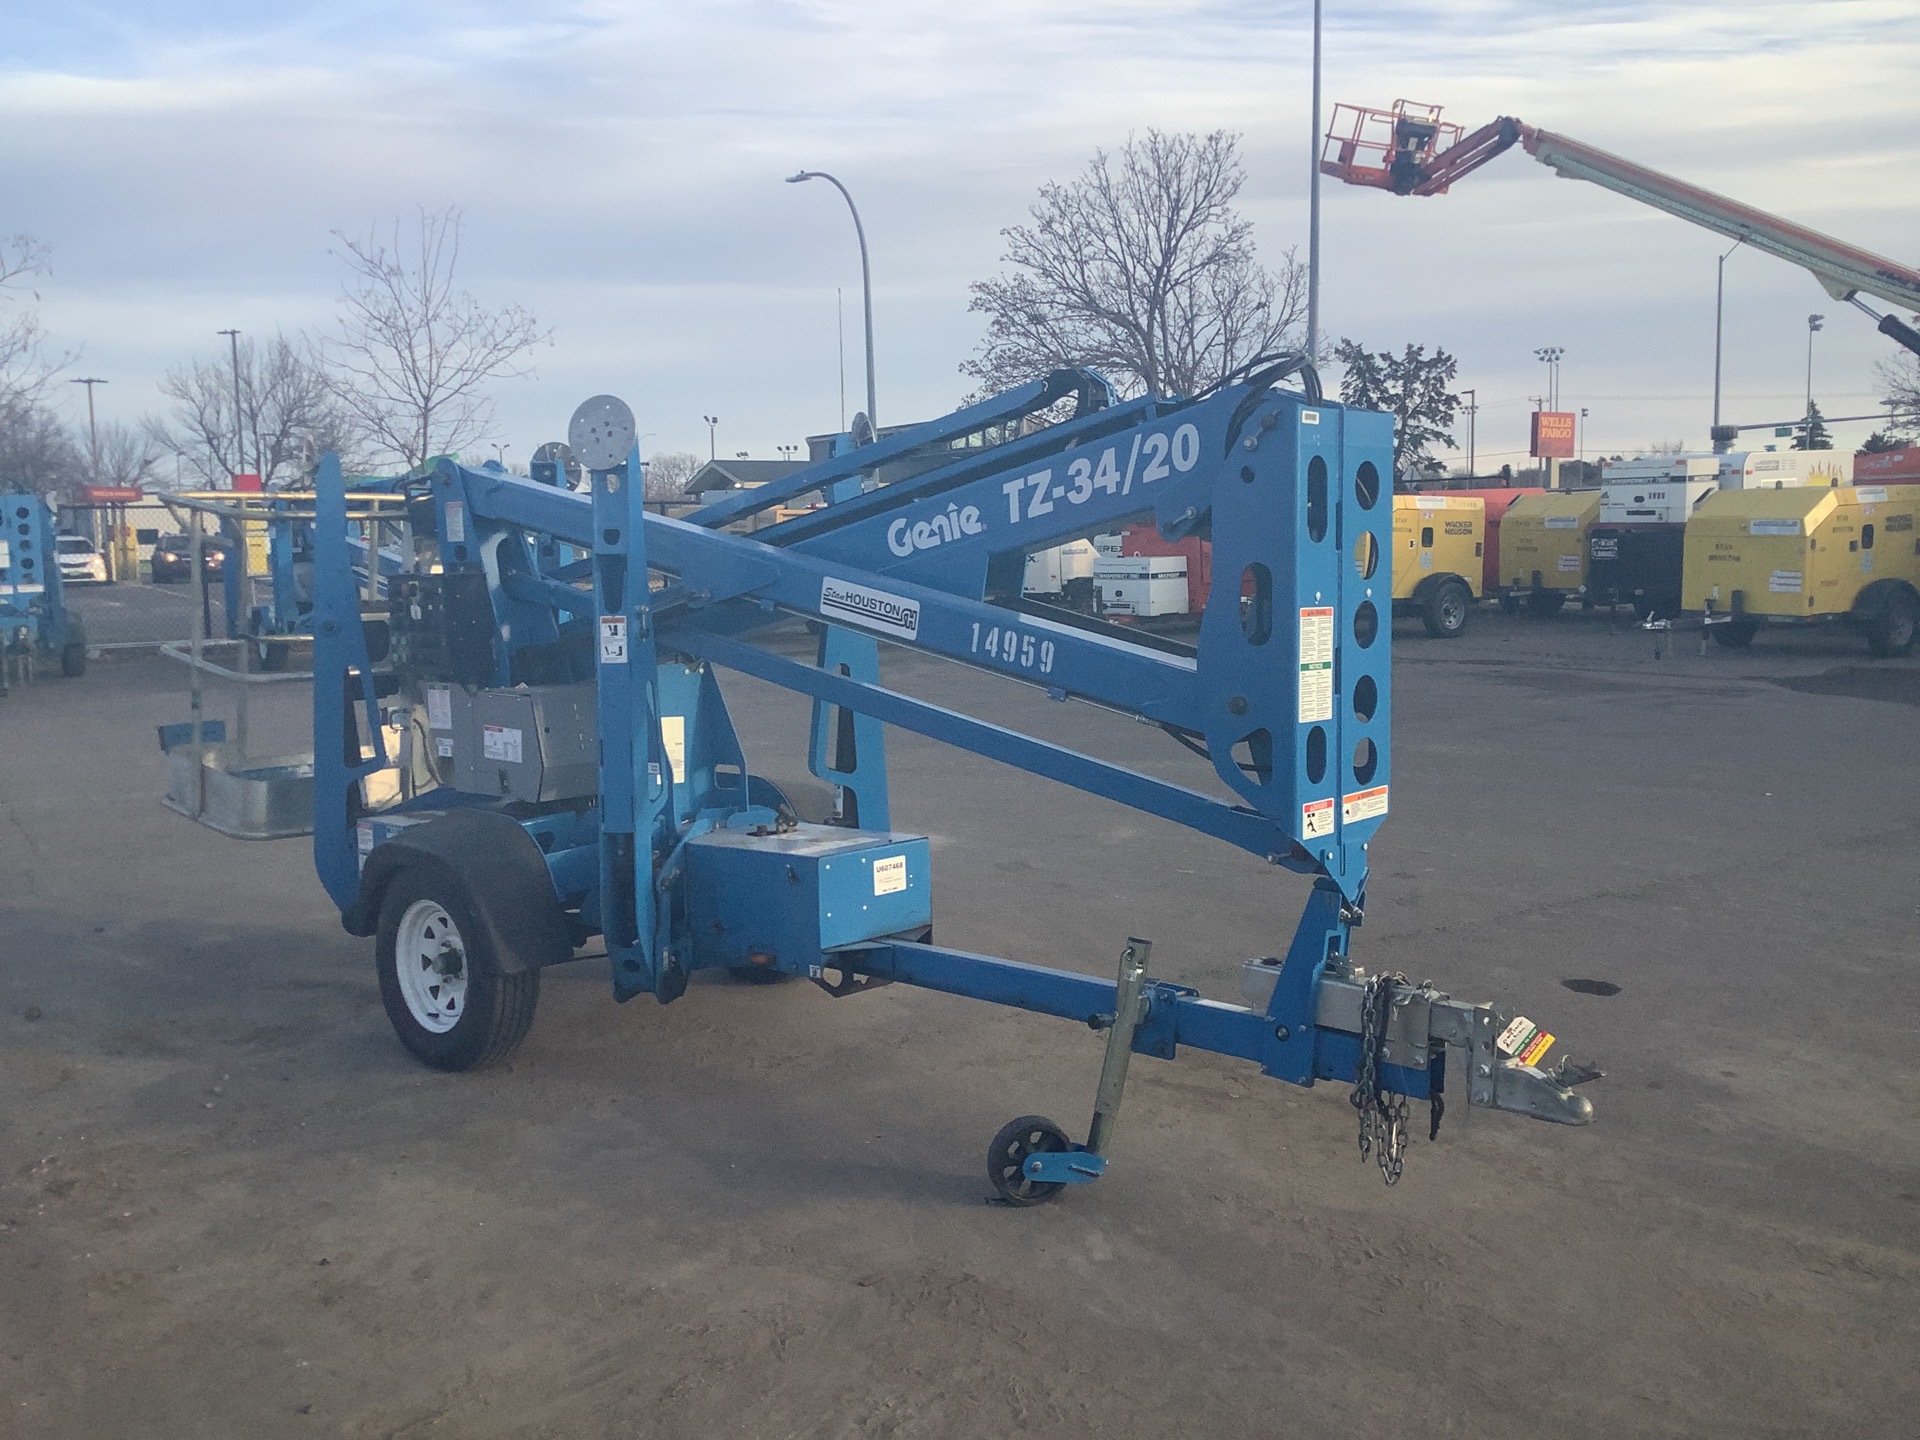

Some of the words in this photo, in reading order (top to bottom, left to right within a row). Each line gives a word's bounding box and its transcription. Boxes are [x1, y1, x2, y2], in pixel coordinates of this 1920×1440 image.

[1541, 416, 1572, 427] WELLS
[1541, 427, 1571, 438] FARGO
[1003, 423, 1200, 524] TZ-34/20
[887, 502, 982, 557] Genie
[823, 587, 846, 601] Stan
[845, 591, 901, 617] HOUSTON
[971, 622, 1055, 673] 14959
[876, 861, 904, 873] U607468
